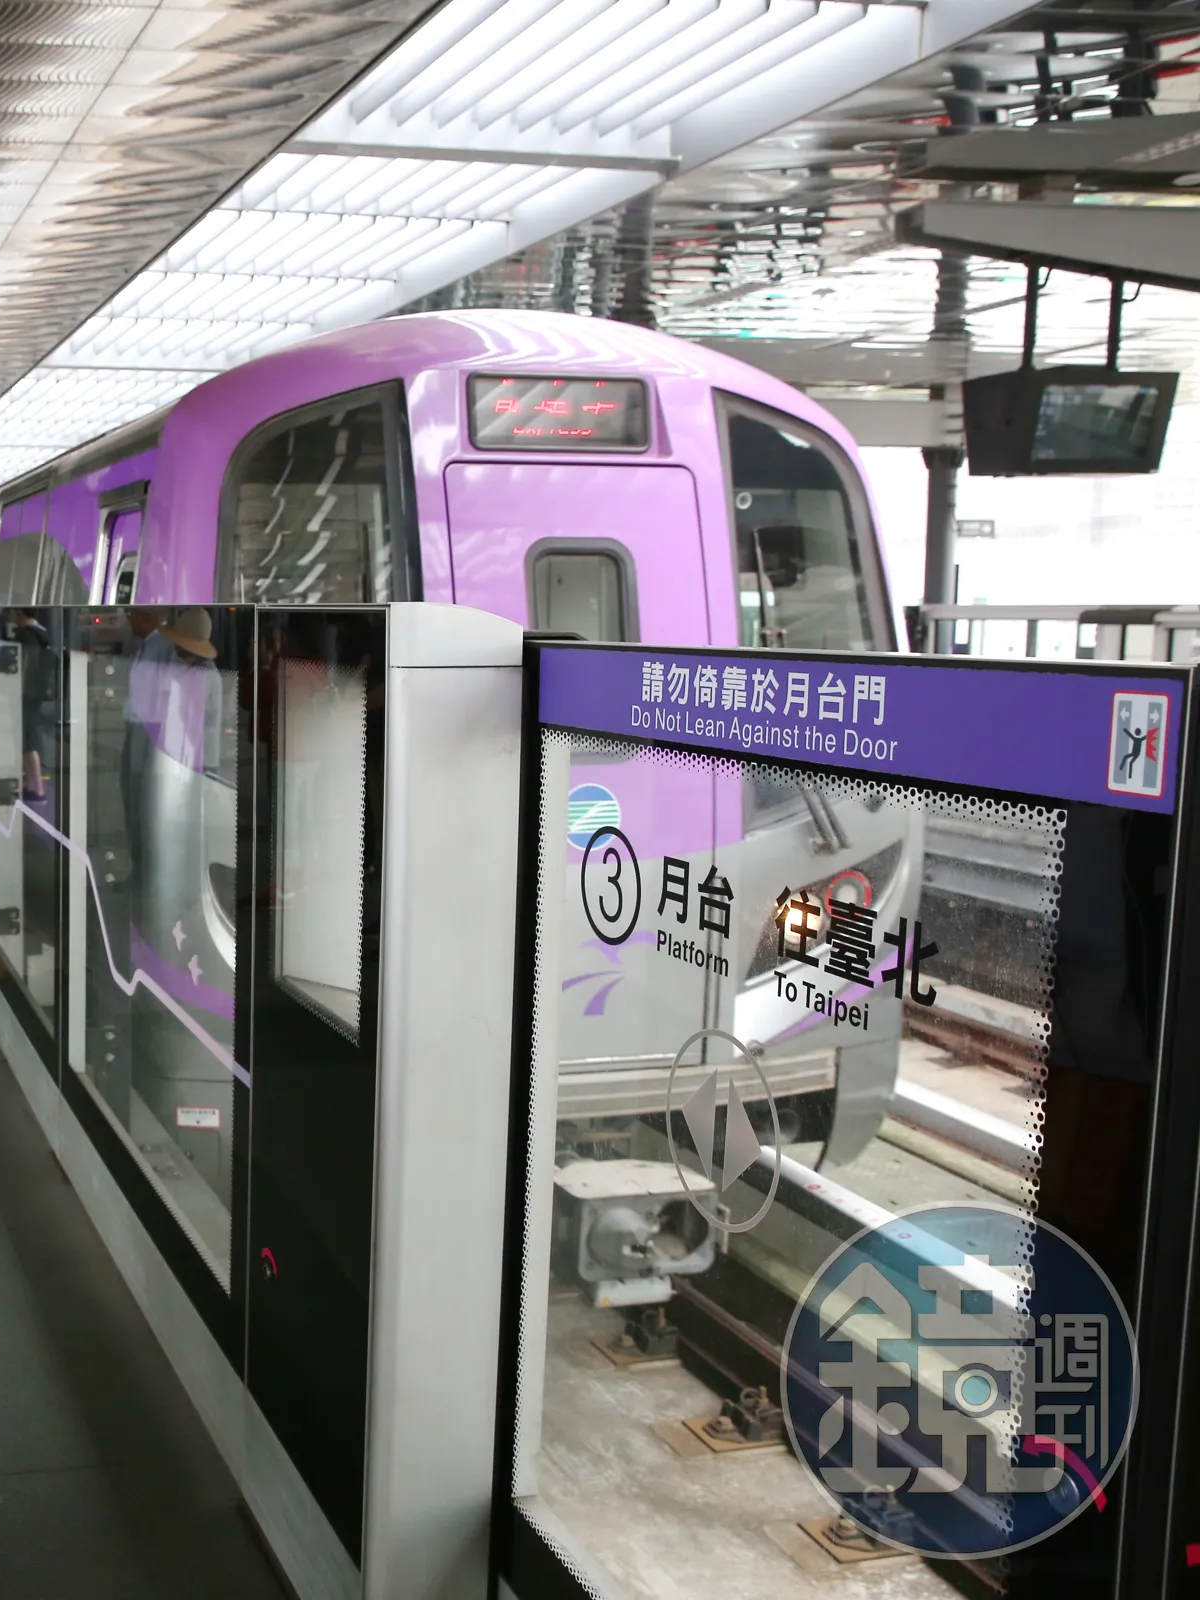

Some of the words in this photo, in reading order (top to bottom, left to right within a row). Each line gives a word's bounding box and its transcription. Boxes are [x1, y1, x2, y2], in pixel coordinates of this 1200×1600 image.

[641, 661, 886, 726] 請勿倚靠於月台門
[631, 704, 650, 728] Do
[655, 707, 681, 733] Not
[685, 711, 725, 738] Lean
[729, 716, 799, 749] Against
[805, 726, 837, 753] the
[843, 729, 898, 761] Door
[657, 855, 735, 940] 月台
[657, 929, 729, 977] Platform
[774, 886, 939, 1007] 往臺北
[774, 971, 798, 1002] To
[803, 981, 869, 1031] Taipei
